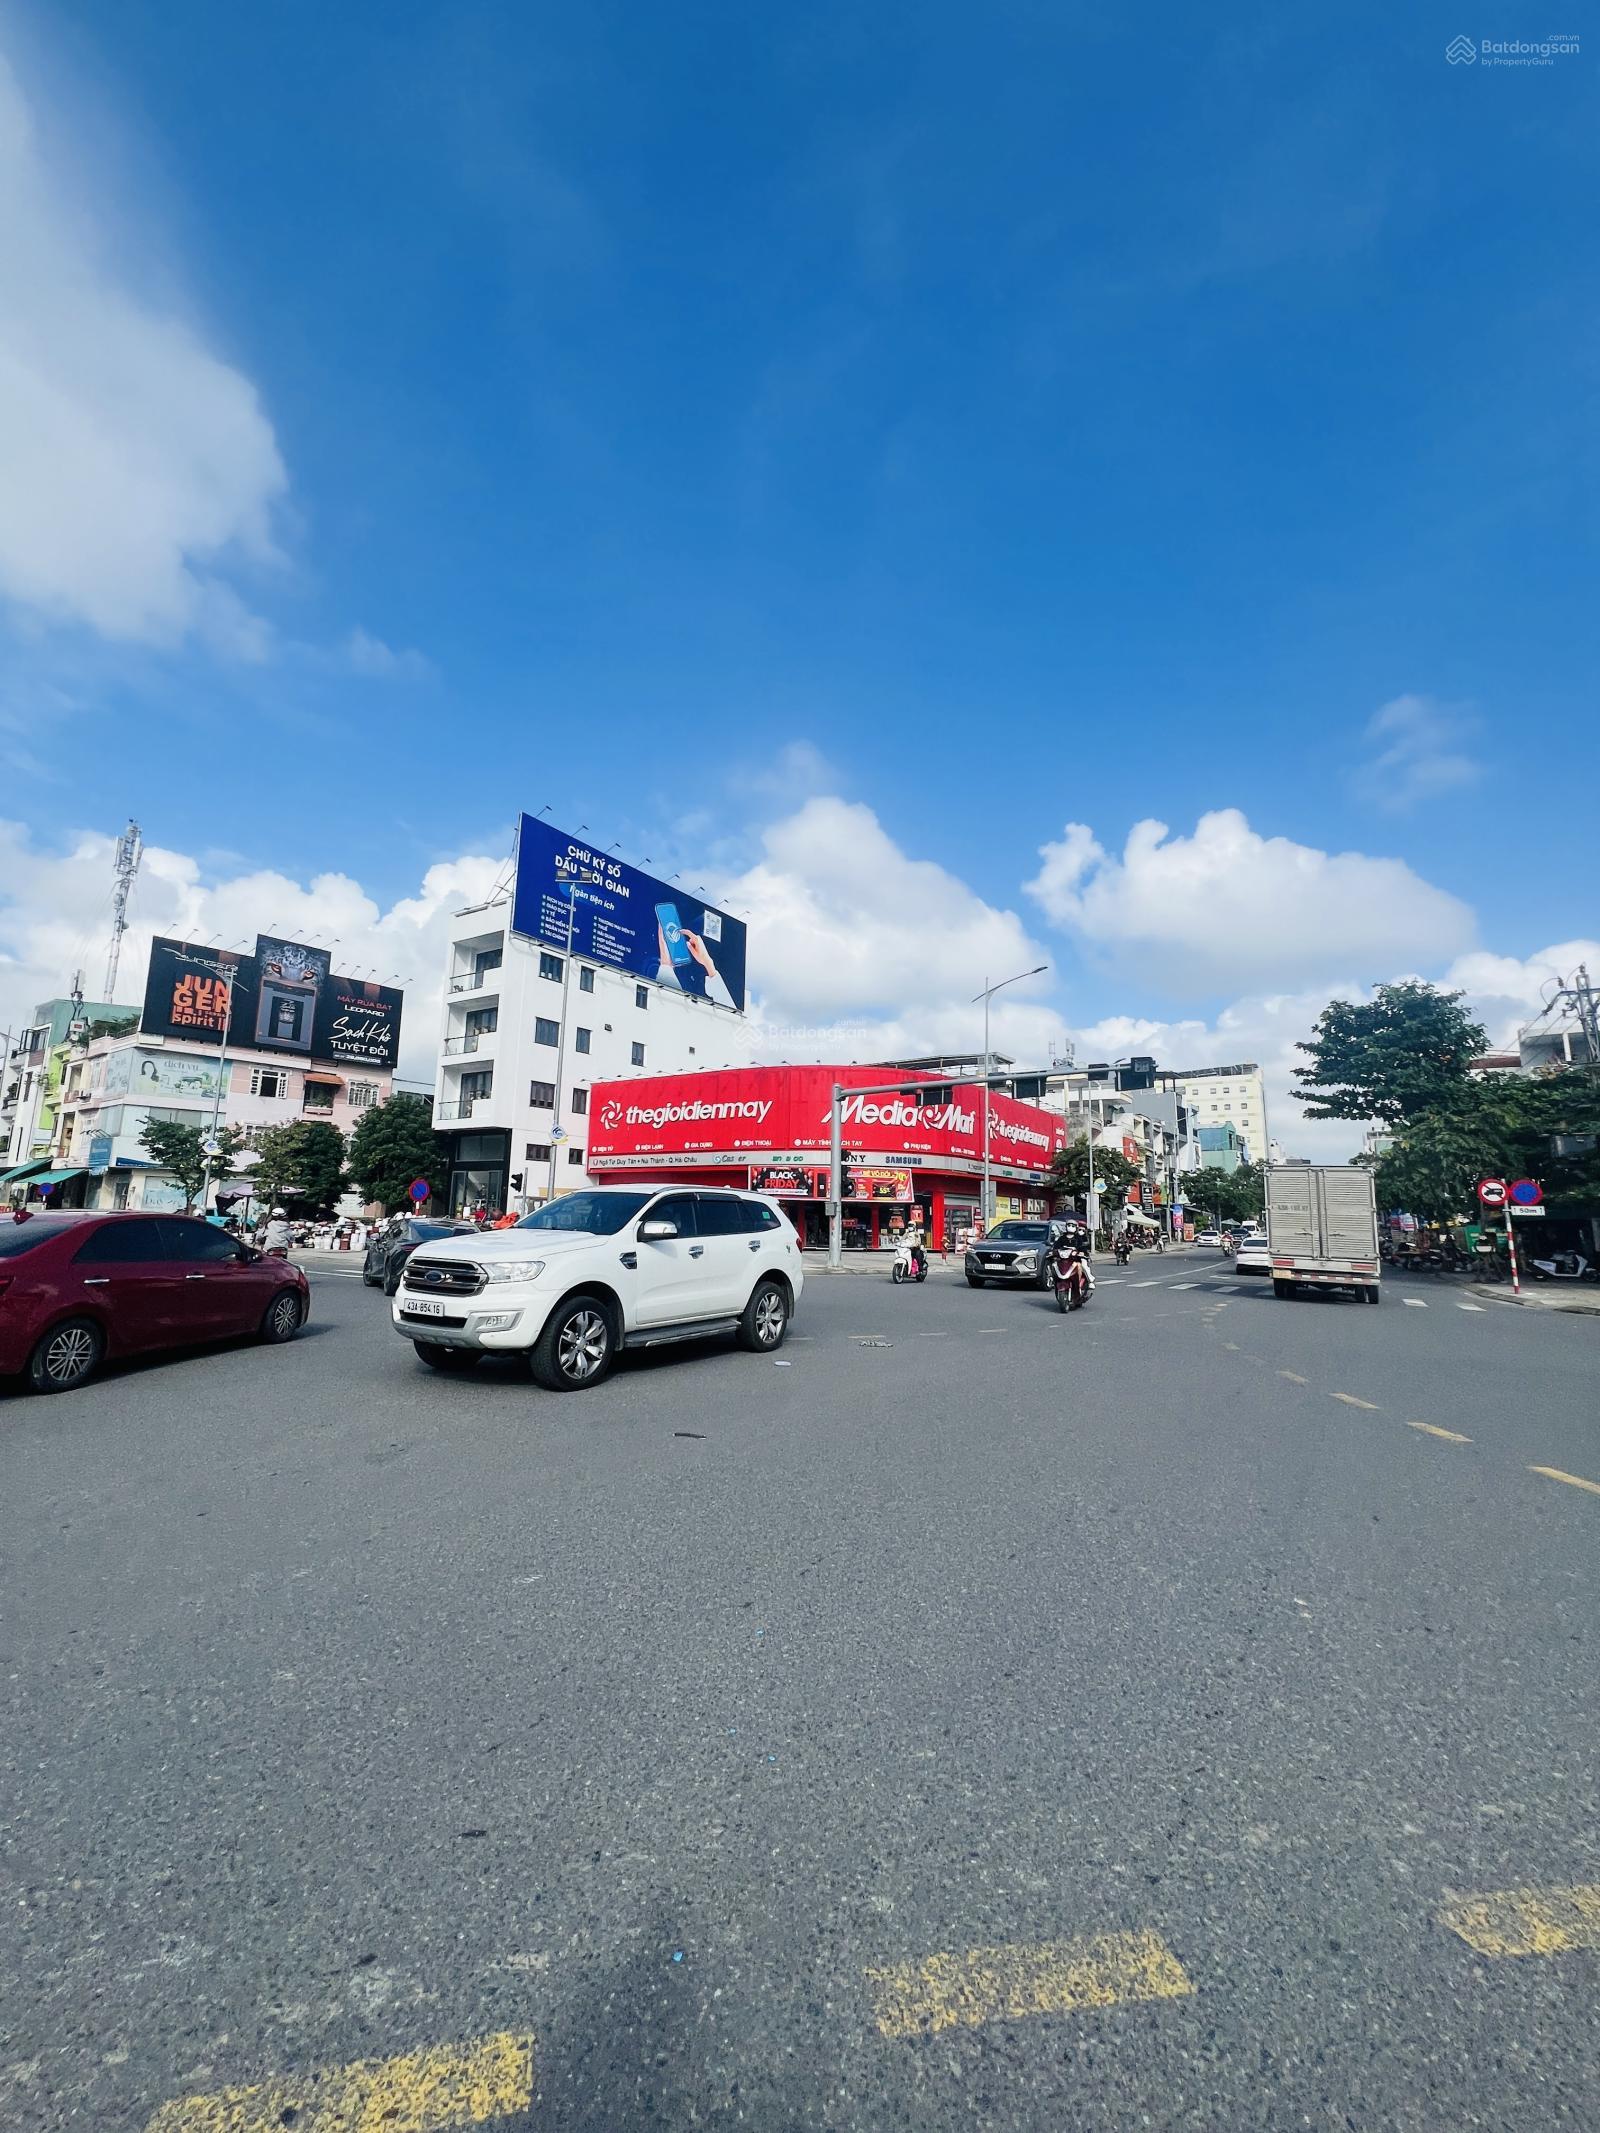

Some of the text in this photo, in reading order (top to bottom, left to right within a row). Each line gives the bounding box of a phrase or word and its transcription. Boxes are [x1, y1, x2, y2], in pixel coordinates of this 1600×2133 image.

[567, 845, 621, 878] CHỮ KÝ SỐ
[554, 854, 630, 898] DẤU ỜI GIAN
[344, 1004, 385, 1017] LEOPARD
[173, 1013, 215, 1028] spirit
[330, 1040, 368, 1053] TUYỆT
[625, 1100, 773, 1129] thegioidienmay
[820, 1094, 977, 1135] Media Mart
[845, 1154, 866, 1163] ONY
[885, 1156, 922, 1165] SAMSUNG
[764, 1179, 800, 1189] FRIDAY
